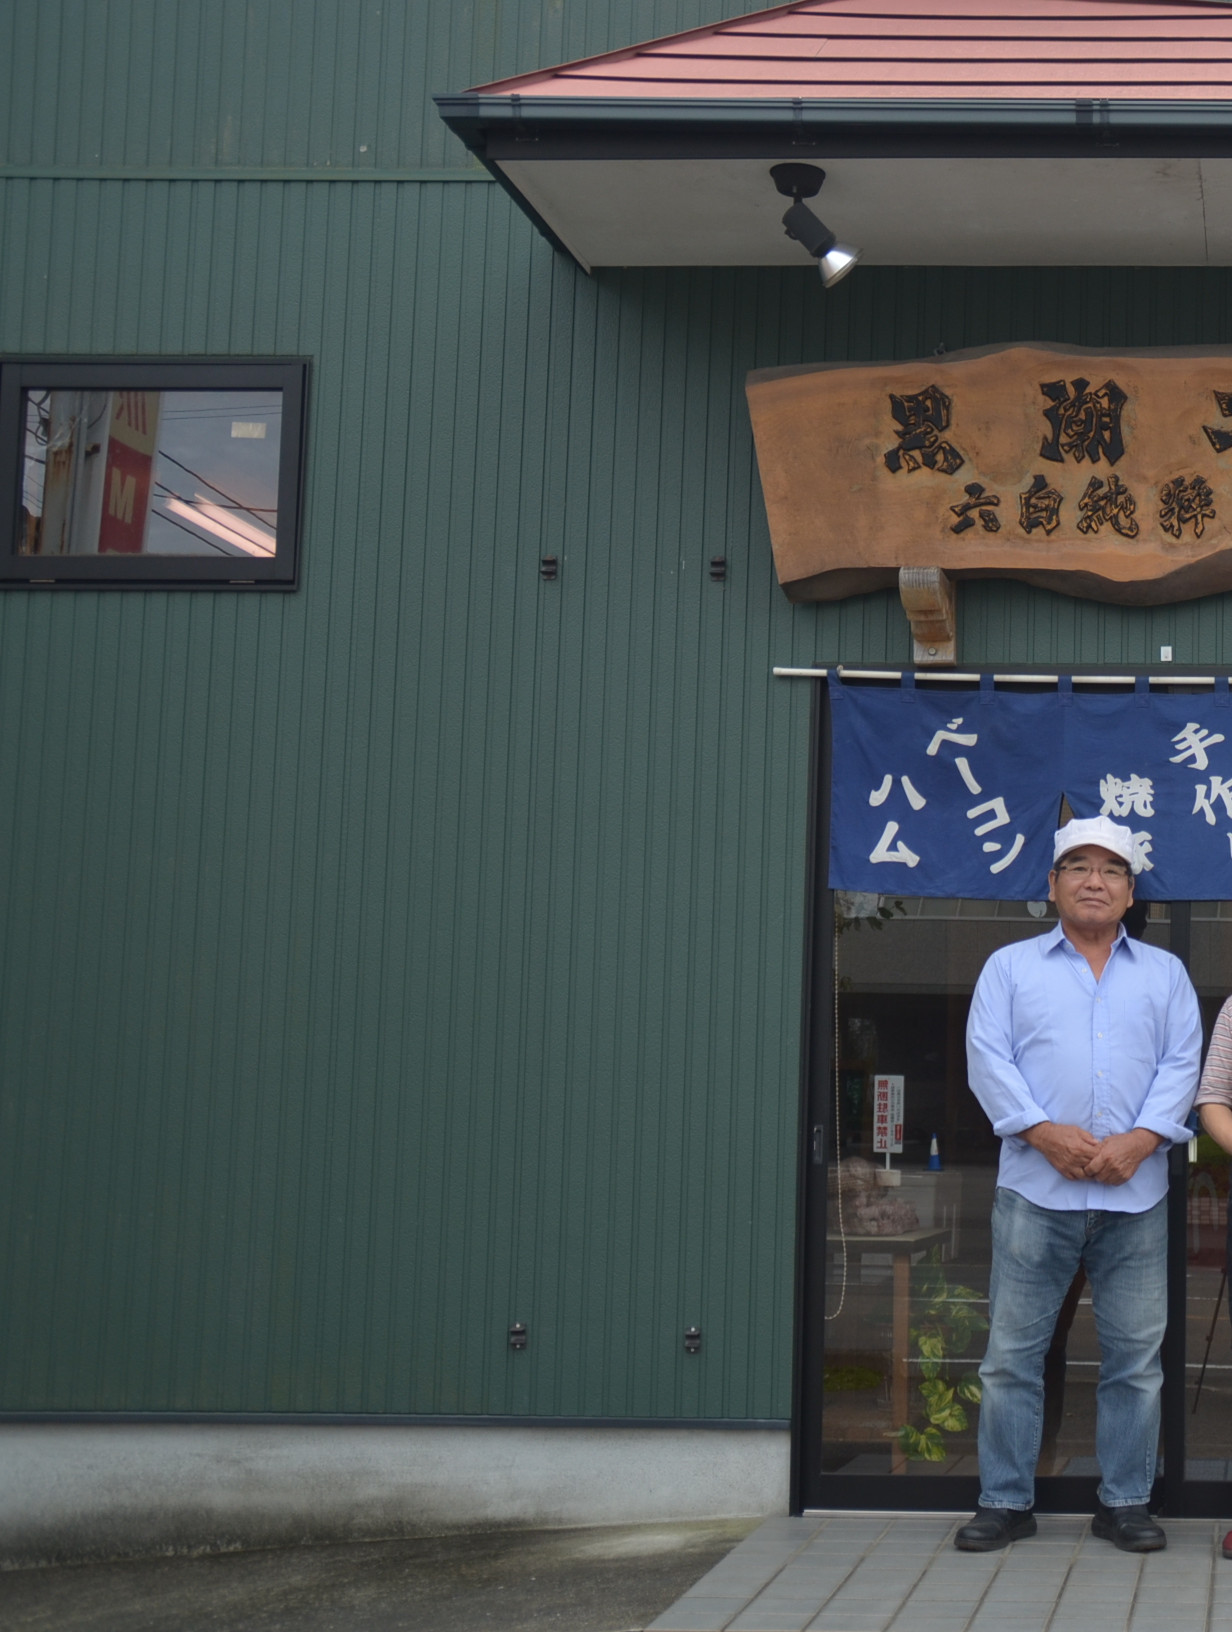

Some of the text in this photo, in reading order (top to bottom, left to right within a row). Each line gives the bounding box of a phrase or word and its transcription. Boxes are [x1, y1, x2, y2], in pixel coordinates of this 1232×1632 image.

[869, 774, 927, 868] ハム
[926, 717, 1026, 875] ベーコン
